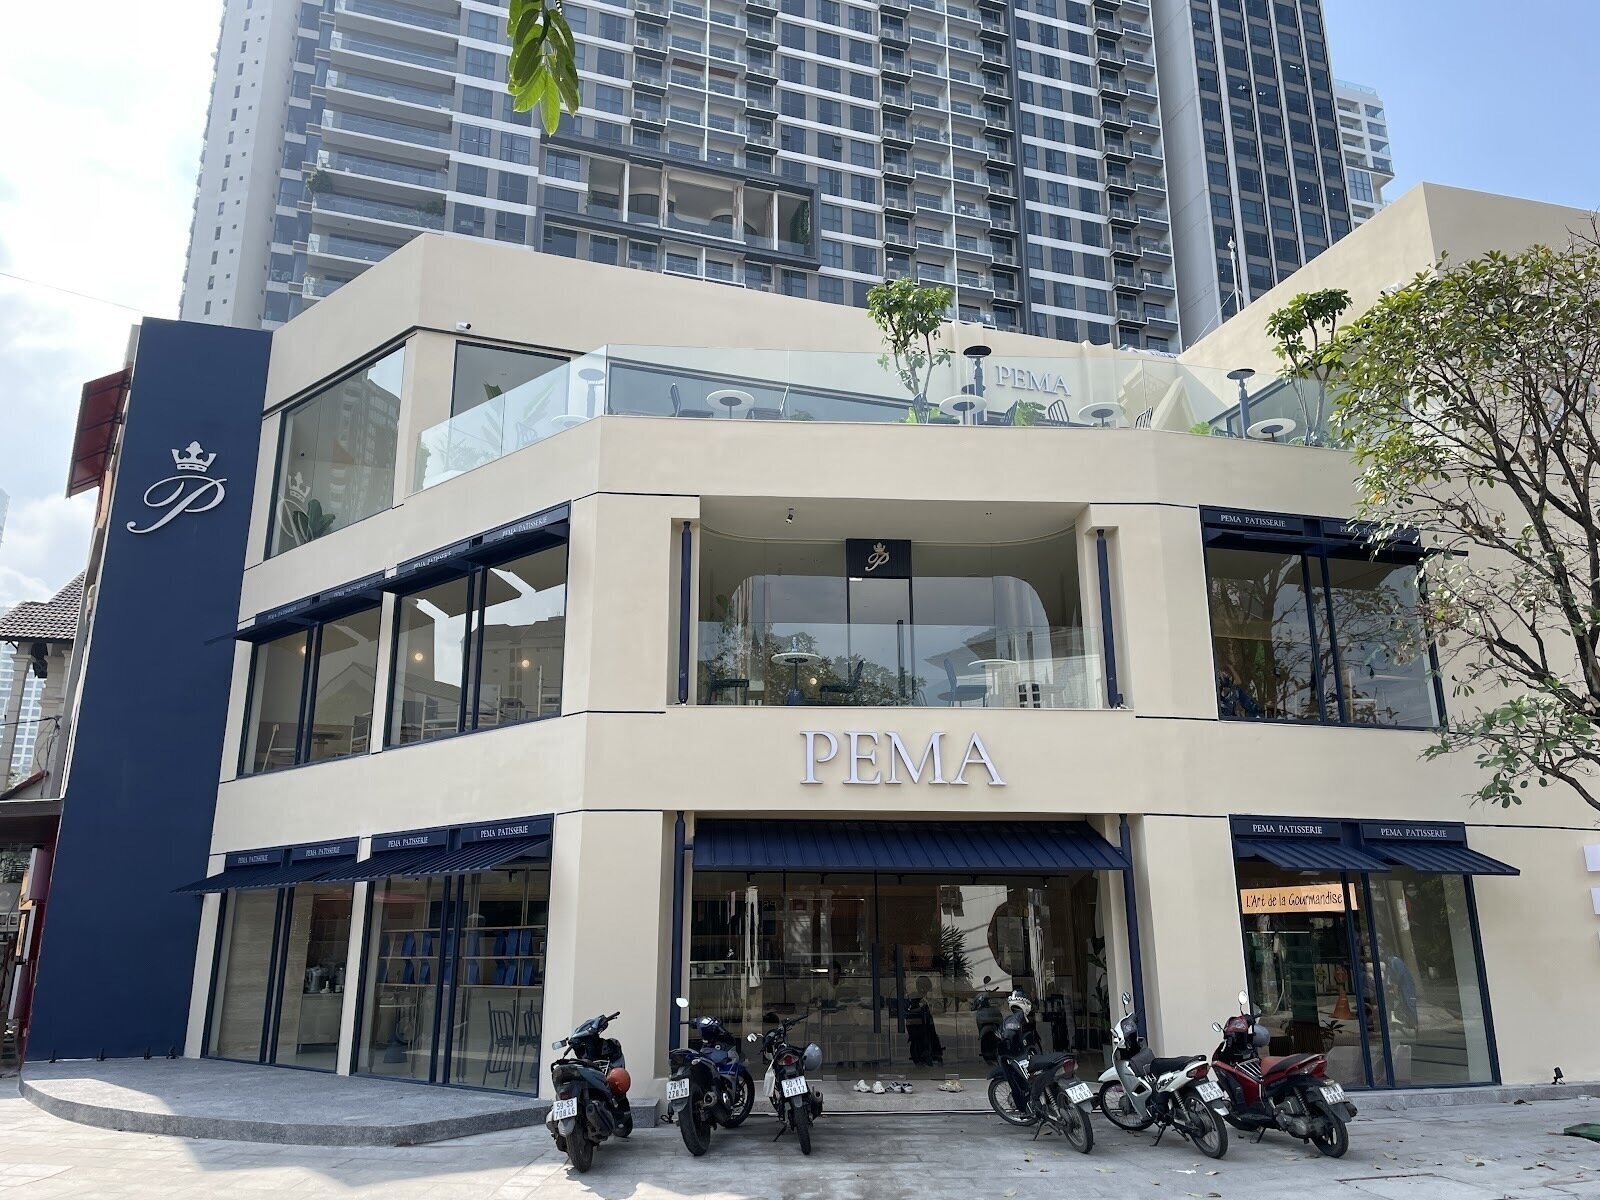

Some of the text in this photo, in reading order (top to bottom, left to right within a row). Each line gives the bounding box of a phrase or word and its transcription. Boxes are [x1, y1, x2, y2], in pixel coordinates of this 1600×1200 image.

[995, 365, 1072, 397] PEMA
[126, 474, 228, 534] P
[518, 516, 548, 532] PATISSERIE
[1220, 514, 1286, 528] PEMA PATISSERIE
[799, 730, 1008, 787] PEMA
[480, 825, 529, 838] PEMA PATISSERIE
[1252, 824, 1323, 835] PEMA PATISSERIE
[1380, 828, 1447, 838] PEMA PATISSERIE
[387, 836, 429, 848] PEMA PATISSERIE
[1246, 891, 1343, 908] L'Art de la Gourmandise
[556, 1099, 574, 1111] 59-S3
